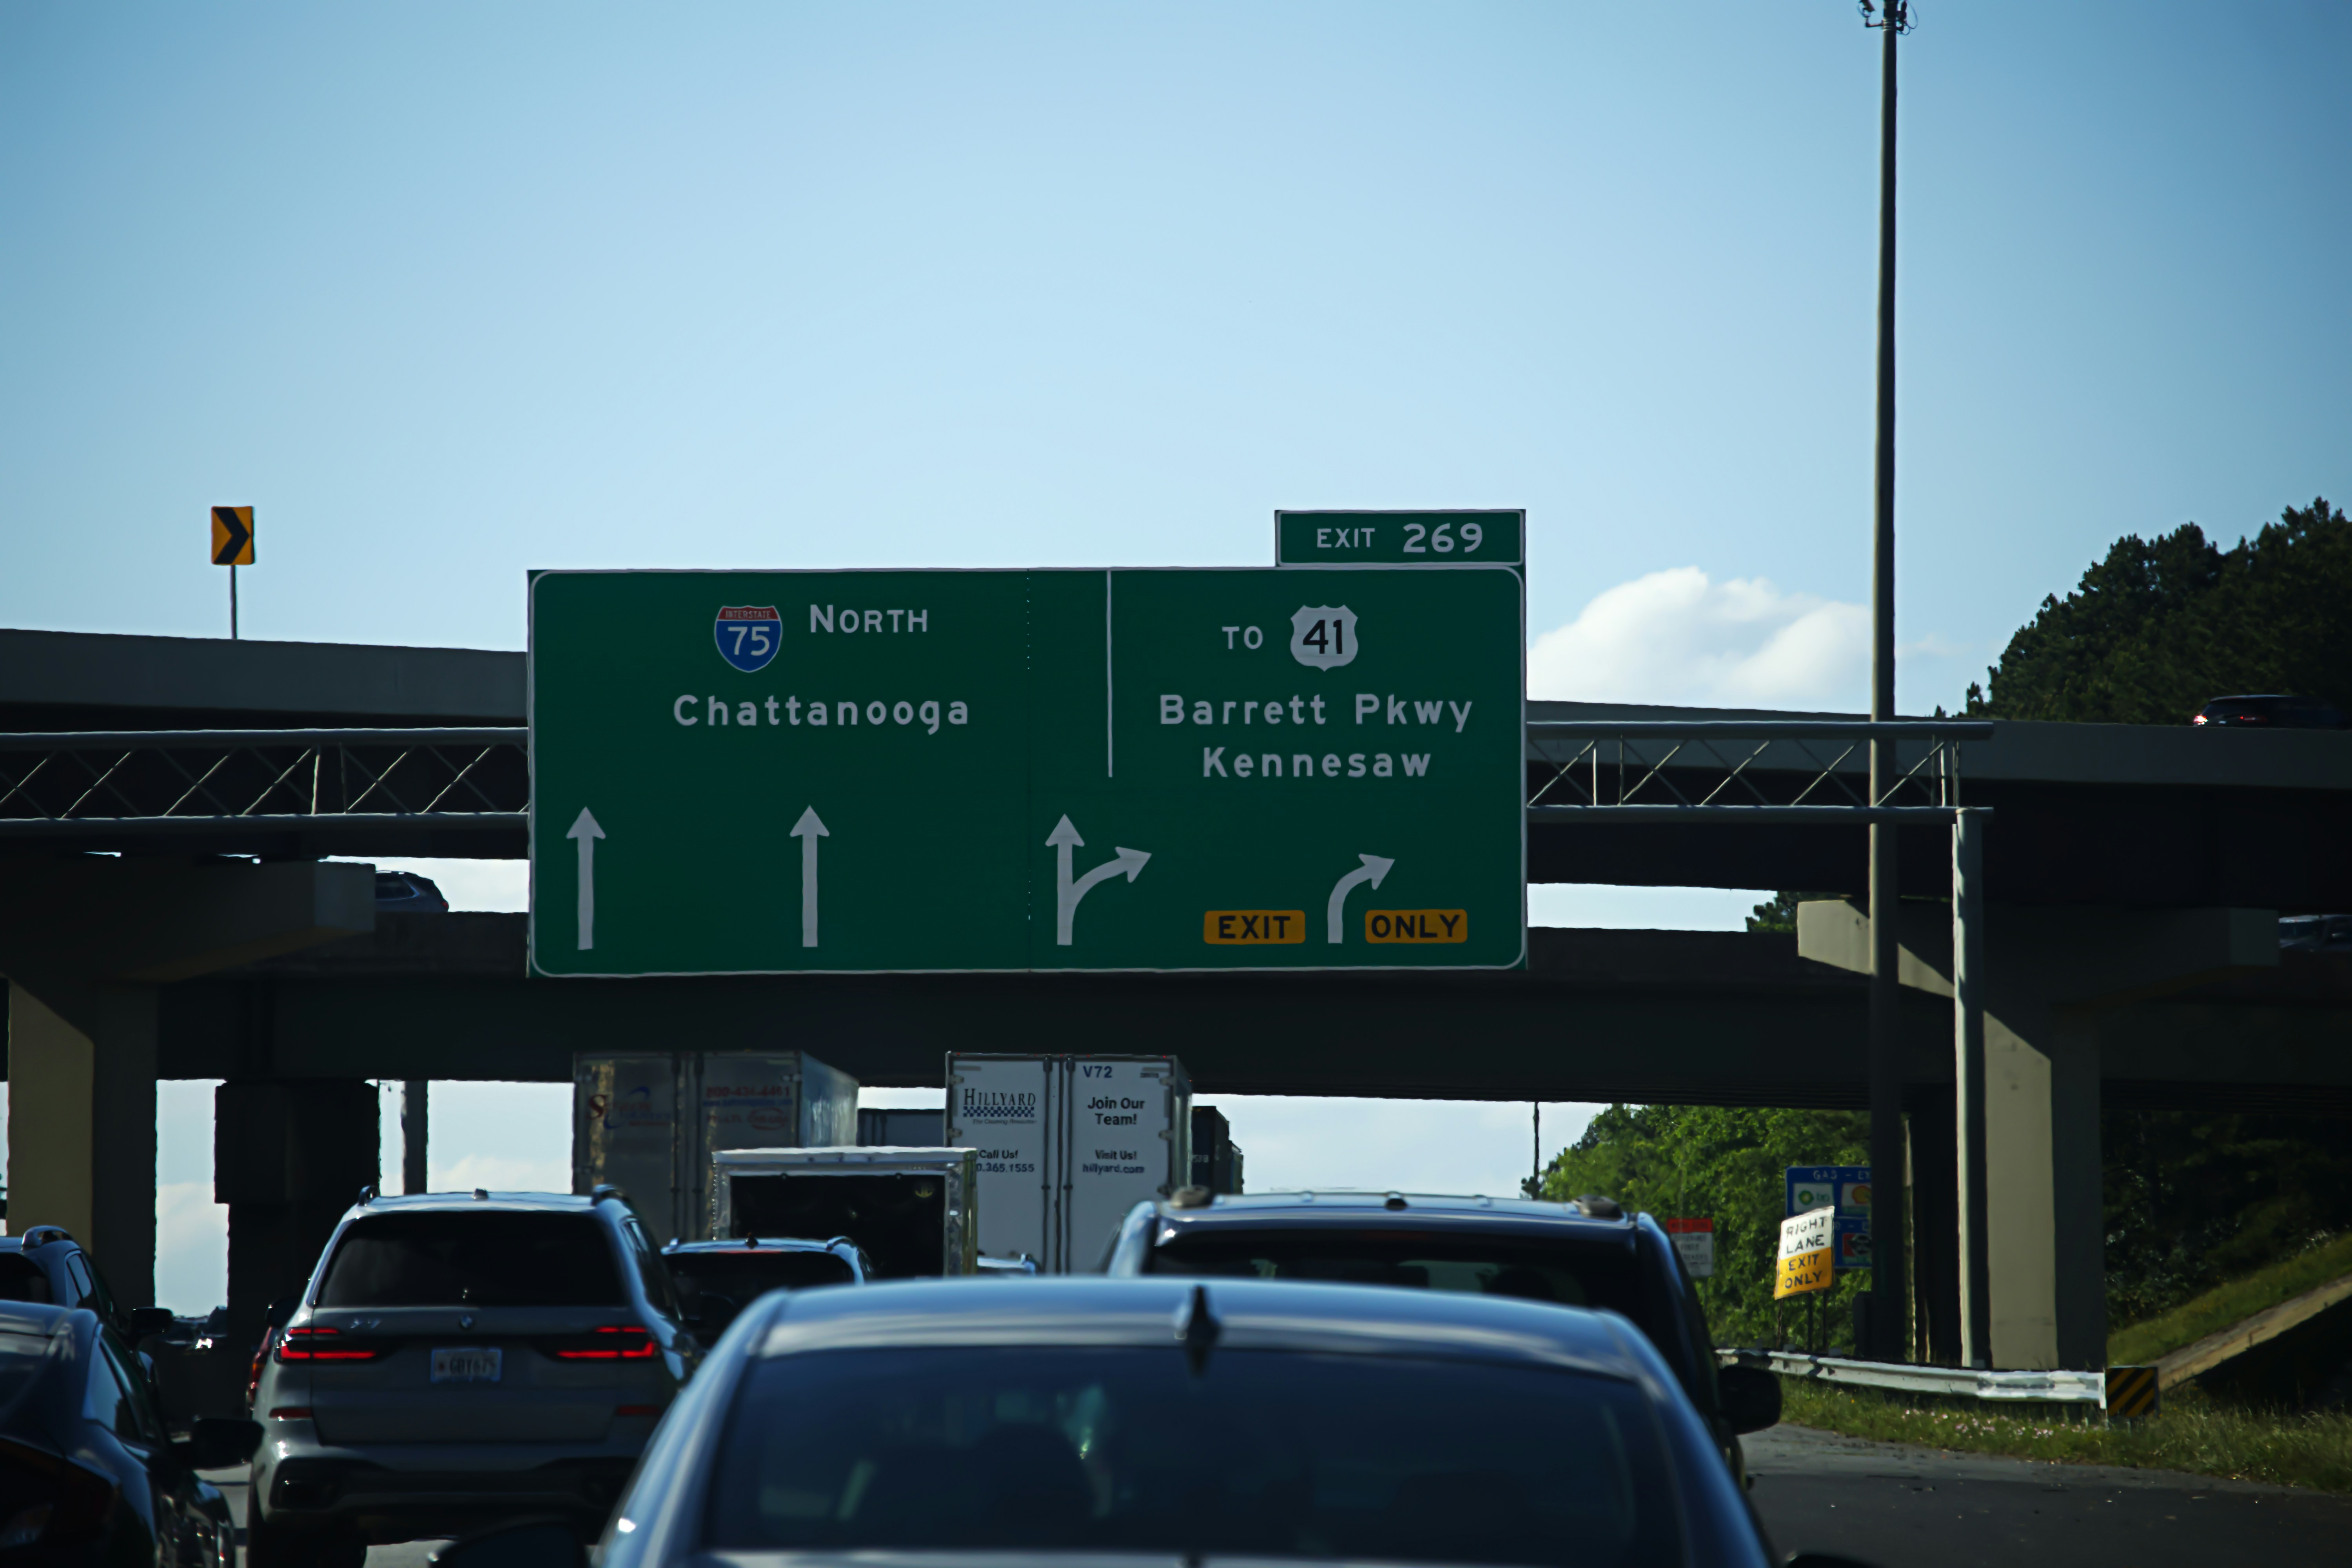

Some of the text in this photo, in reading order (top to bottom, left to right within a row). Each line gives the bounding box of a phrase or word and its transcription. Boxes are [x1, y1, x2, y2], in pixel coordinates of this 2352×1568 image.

[1318, 523, 1483, 553] EXIT 269
[726, 610, 771, 619] INTERSTATE
[810, 604, 928, 633] NORTH
[728, 626, 770, 656] 75
[1222, 626, 1263, 650] TO
[1303, 619, 1343, 655] 41
[674, 695, 968, 735] Chattanooga
[1160, 693, 1473, 733] Barrett Pkwy
[1203, 747, 1431, 778] Kennesaw
[1219, 915, 1460, 939] EXIT ONLY
[1083, 1066, 1112, 1078] V72
[964, 1089, 1036, 1106] HILLYARD
[1088, 1096, 1145, 1110] Join Our
[1095, 1113, 1137, 1126] Team!
[979, 1150, 1018, 1159] Call Us!
[1095, 1150, 1138, 1160] Visit Us!
[976, 1163, 1035, 1173] 0.365.1555
[1082, 1163, 1145, 1176] hillyard.com
[1813, 1170, 1838, 1181] GAS
[1857, 1170, 1871, 1181] EX
[1786, 1216, 1826, 1237] RIGHT
[1787, 1234, 1825, 1254] LANE
[1789, 1253, 1820, 1271] EXIT
[1785, 1270, 1822, 1289] ONLY
